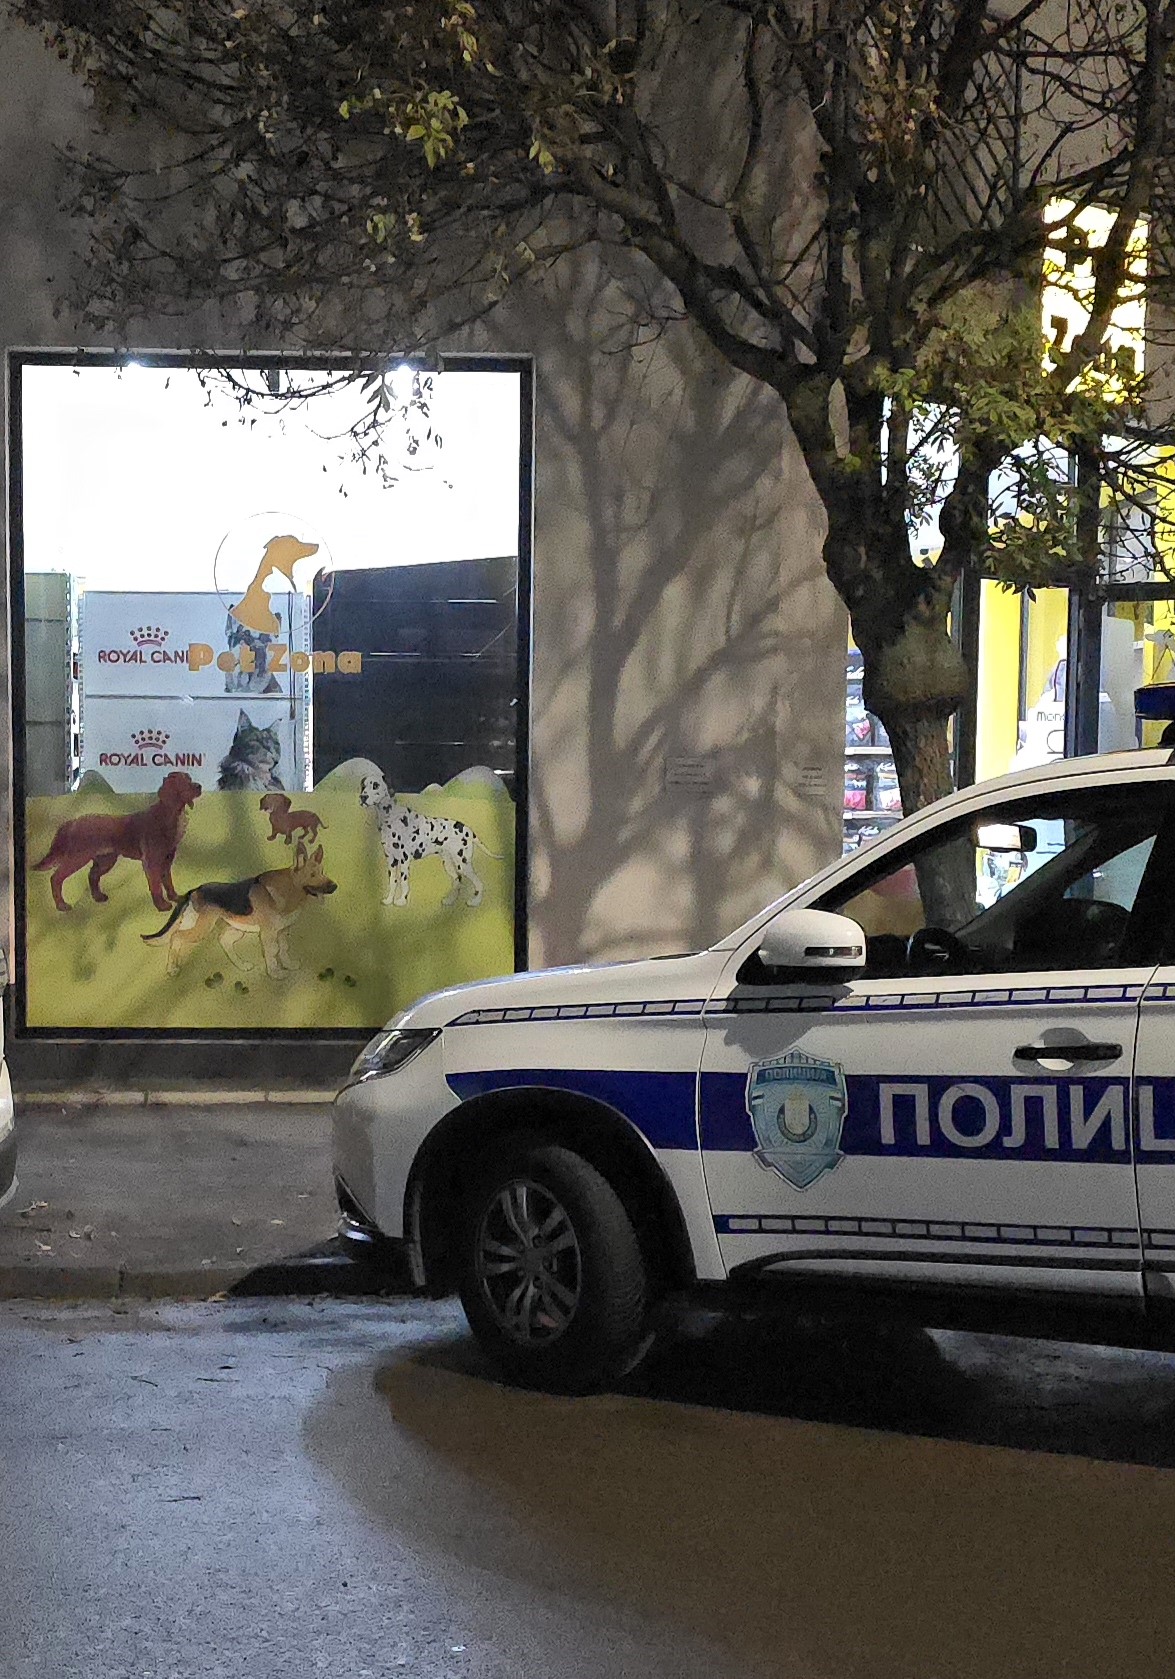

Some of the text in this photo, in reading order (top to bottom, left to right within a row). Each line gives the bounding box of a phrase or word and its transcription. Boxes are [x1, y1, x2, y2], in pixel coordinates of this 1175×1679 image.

[98, 649, 190, 664] ROYAL CANI
[188, 643, 362, 674] Pet Zona
[99, 752, 203, 767] ROYAL CANIN
